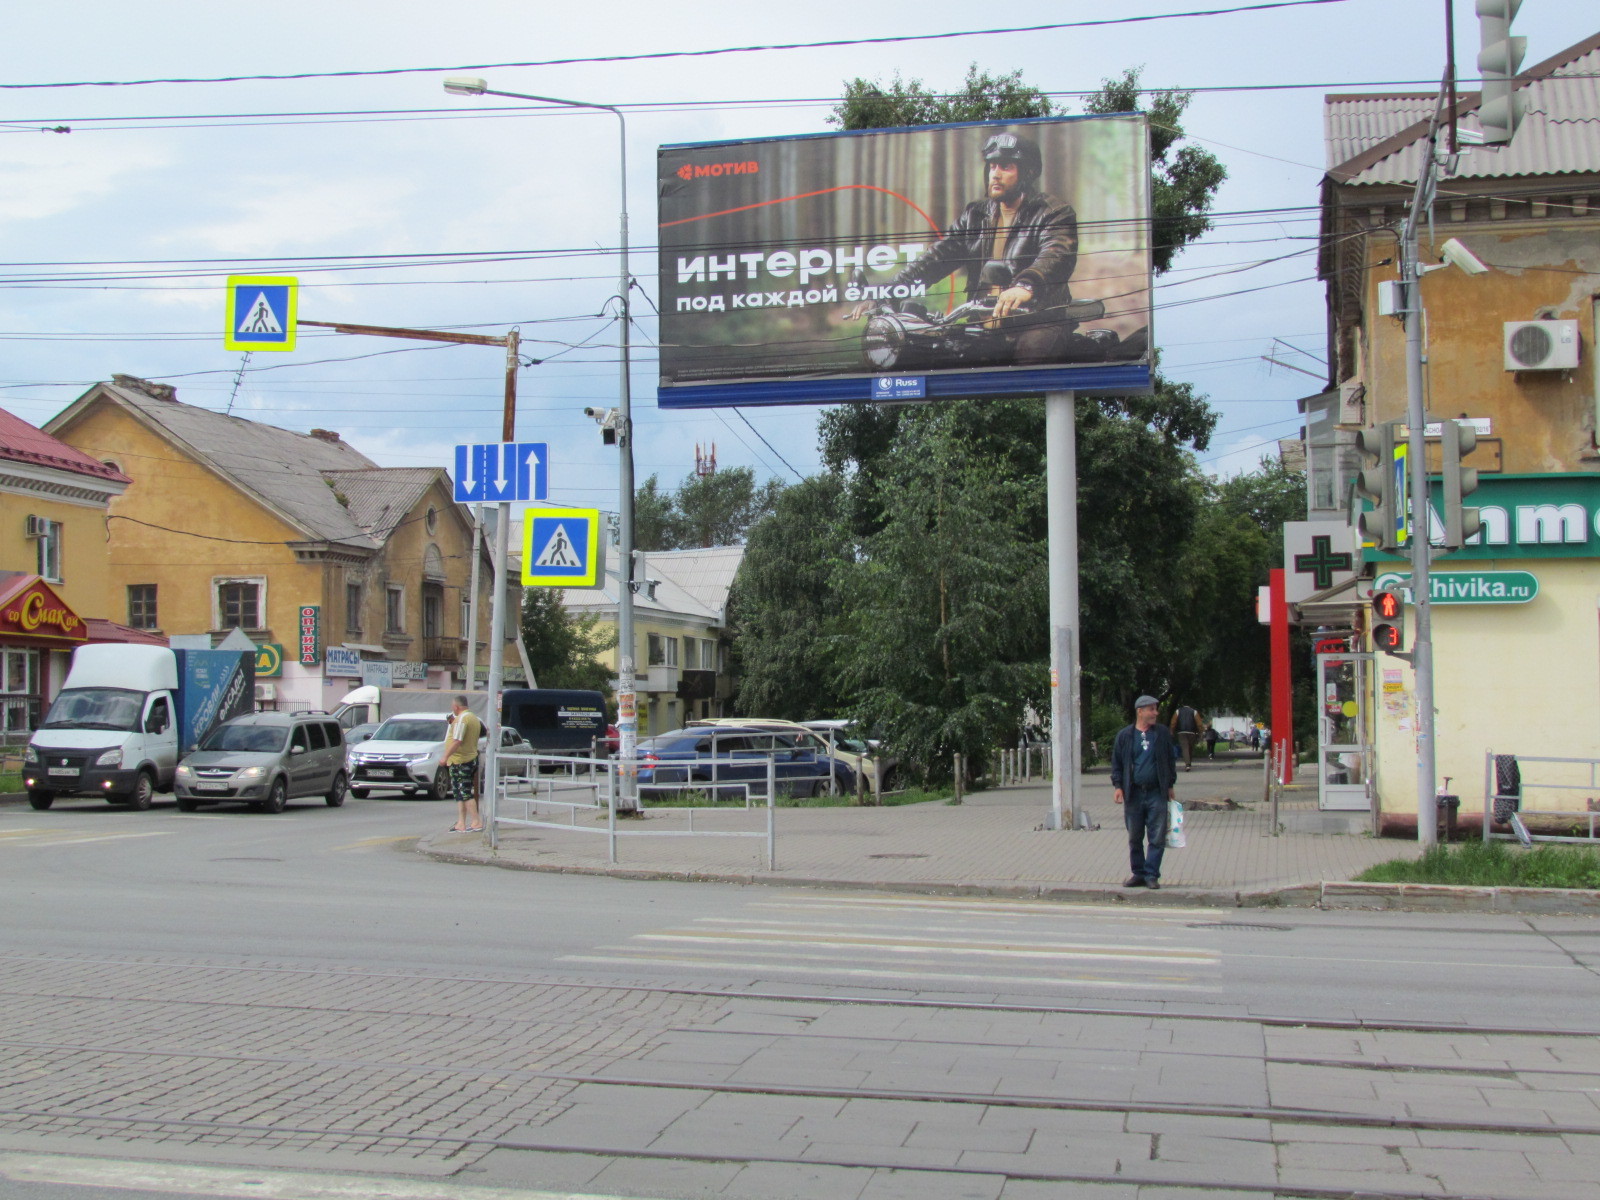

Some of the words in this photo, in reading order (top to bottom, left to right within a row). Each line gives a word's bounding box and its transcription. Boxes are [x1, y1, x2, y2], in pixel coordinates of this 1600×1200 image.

[694, 161, 759, 178] МОТИВ
[677, 243, 924, 284] интернет
[676, 295, 726, 312] под
[732, 284, 838, 309] каждой
[844, 279, 926, 302] ёлкой
[895, 378, 918, 387] Russ
[1428, 577, 1530, 599] hivika.ru
[302, 607, 315, 663] ОПТИКА
[1389, 627, 1398, 646] 3
[327, 650, 360, 664] МАТРАСЫ
[219, 667, 245, 721] ФАСАДЫ
